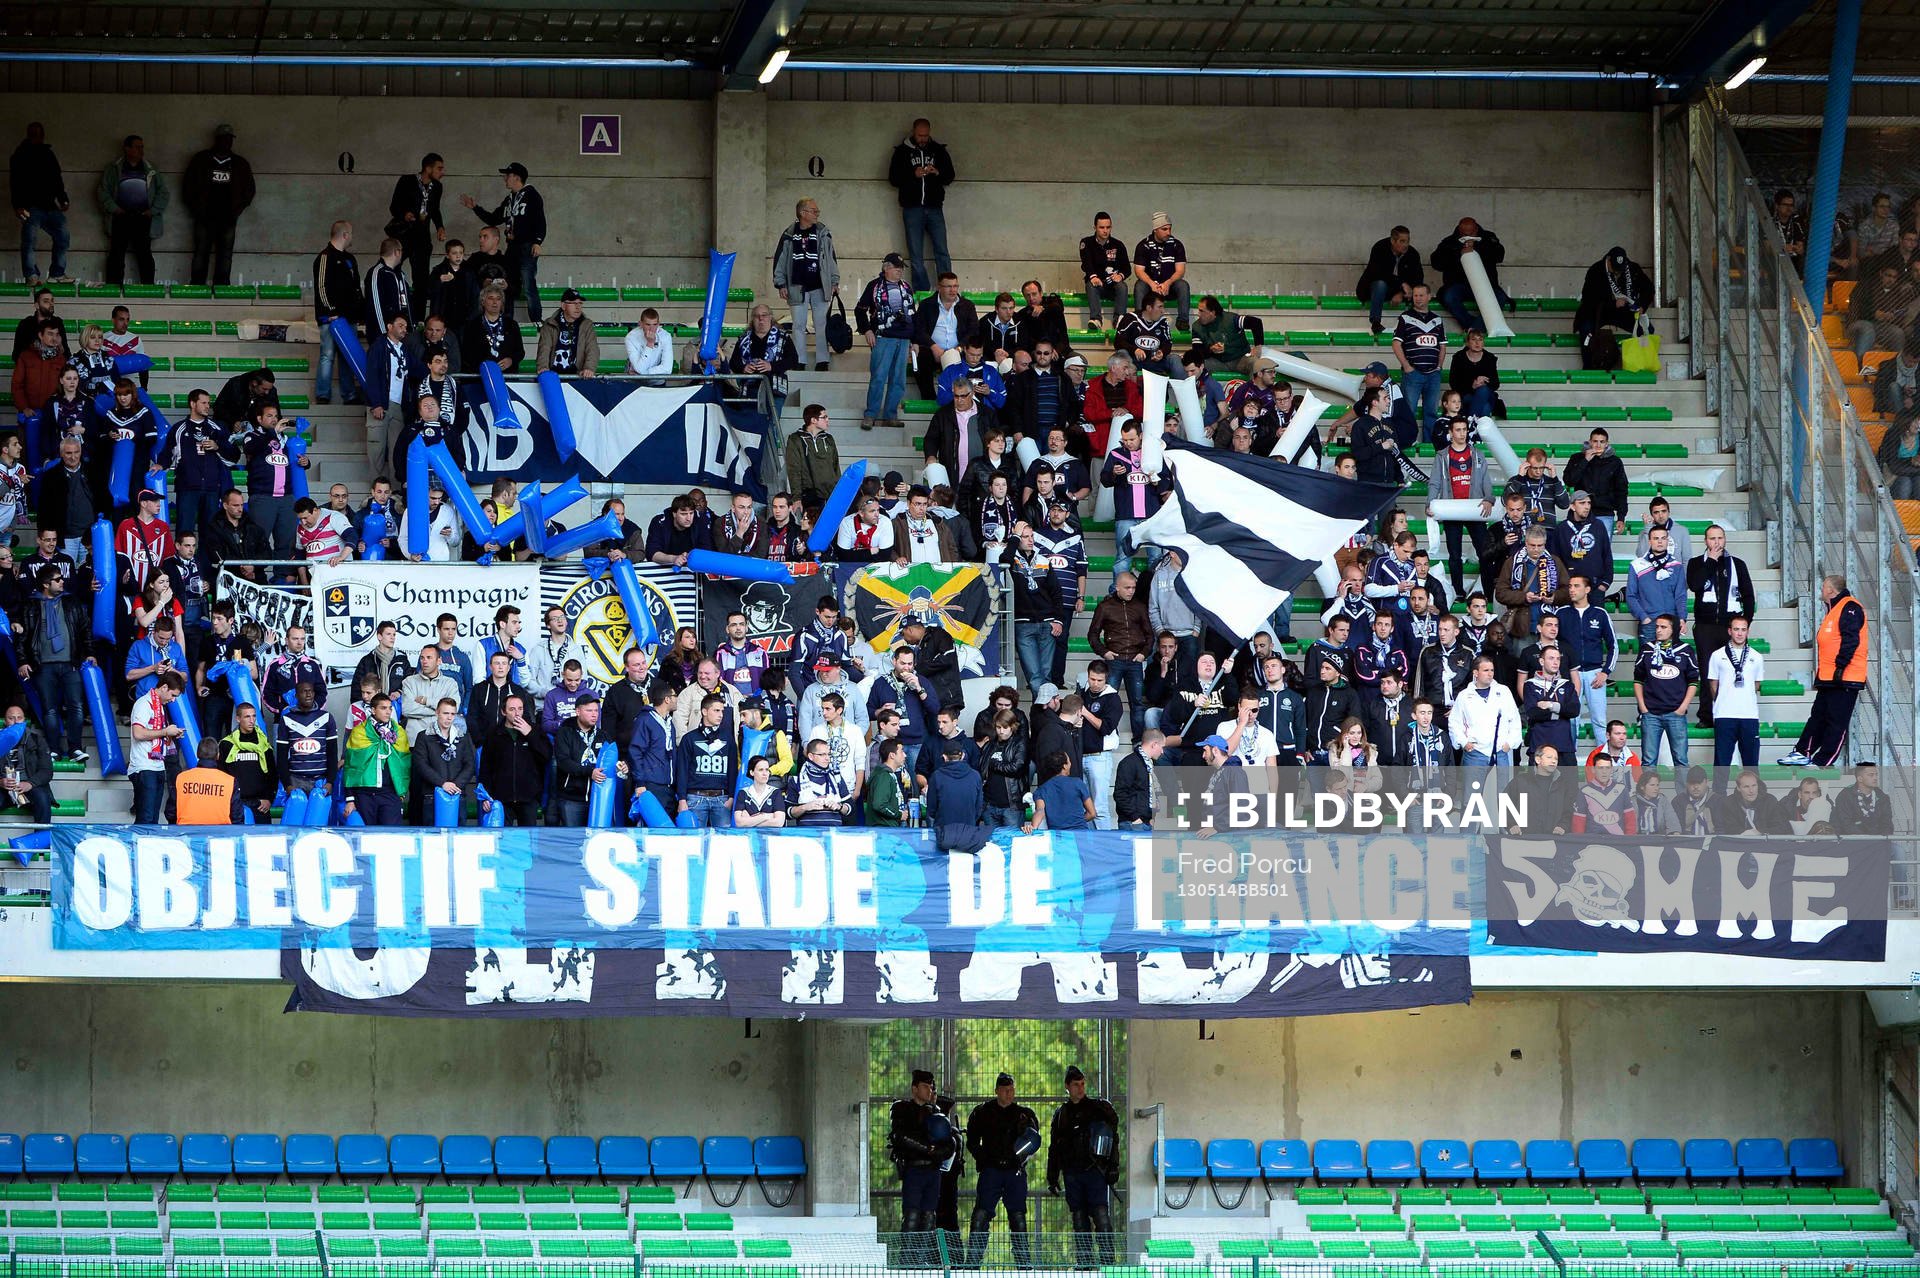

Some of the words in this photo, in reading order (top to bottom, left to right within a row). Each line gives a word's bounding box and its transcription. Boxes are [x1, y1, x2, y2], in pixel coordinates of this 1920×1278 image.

[588, 122, 613, 147] A
[338, 152, 354, 173] Q
[808, 156, 825, 178] Q
[1140, 338, 1156, 347] KIA
[1419, 336, 1436, 346] KIA
[270, 455, 287, 464] KIA
[354, 594, 370, 606] 33
[383, 580, 529, 609] Champagne
[331, 623, 346, 635] 51
[297, 742, 317, 751] KIA
[695, 755, 728, 774] 1881
[182, 782, 225, 797] SECURITE
[73, 831, 497, 931] OBJECTIF
[583, 831, 877, 929] STADE
[947, 834, 1055, 926] DE
[1133, 836, 1472, 932] FRANCE
[744, 1018, 760, 1038] L
